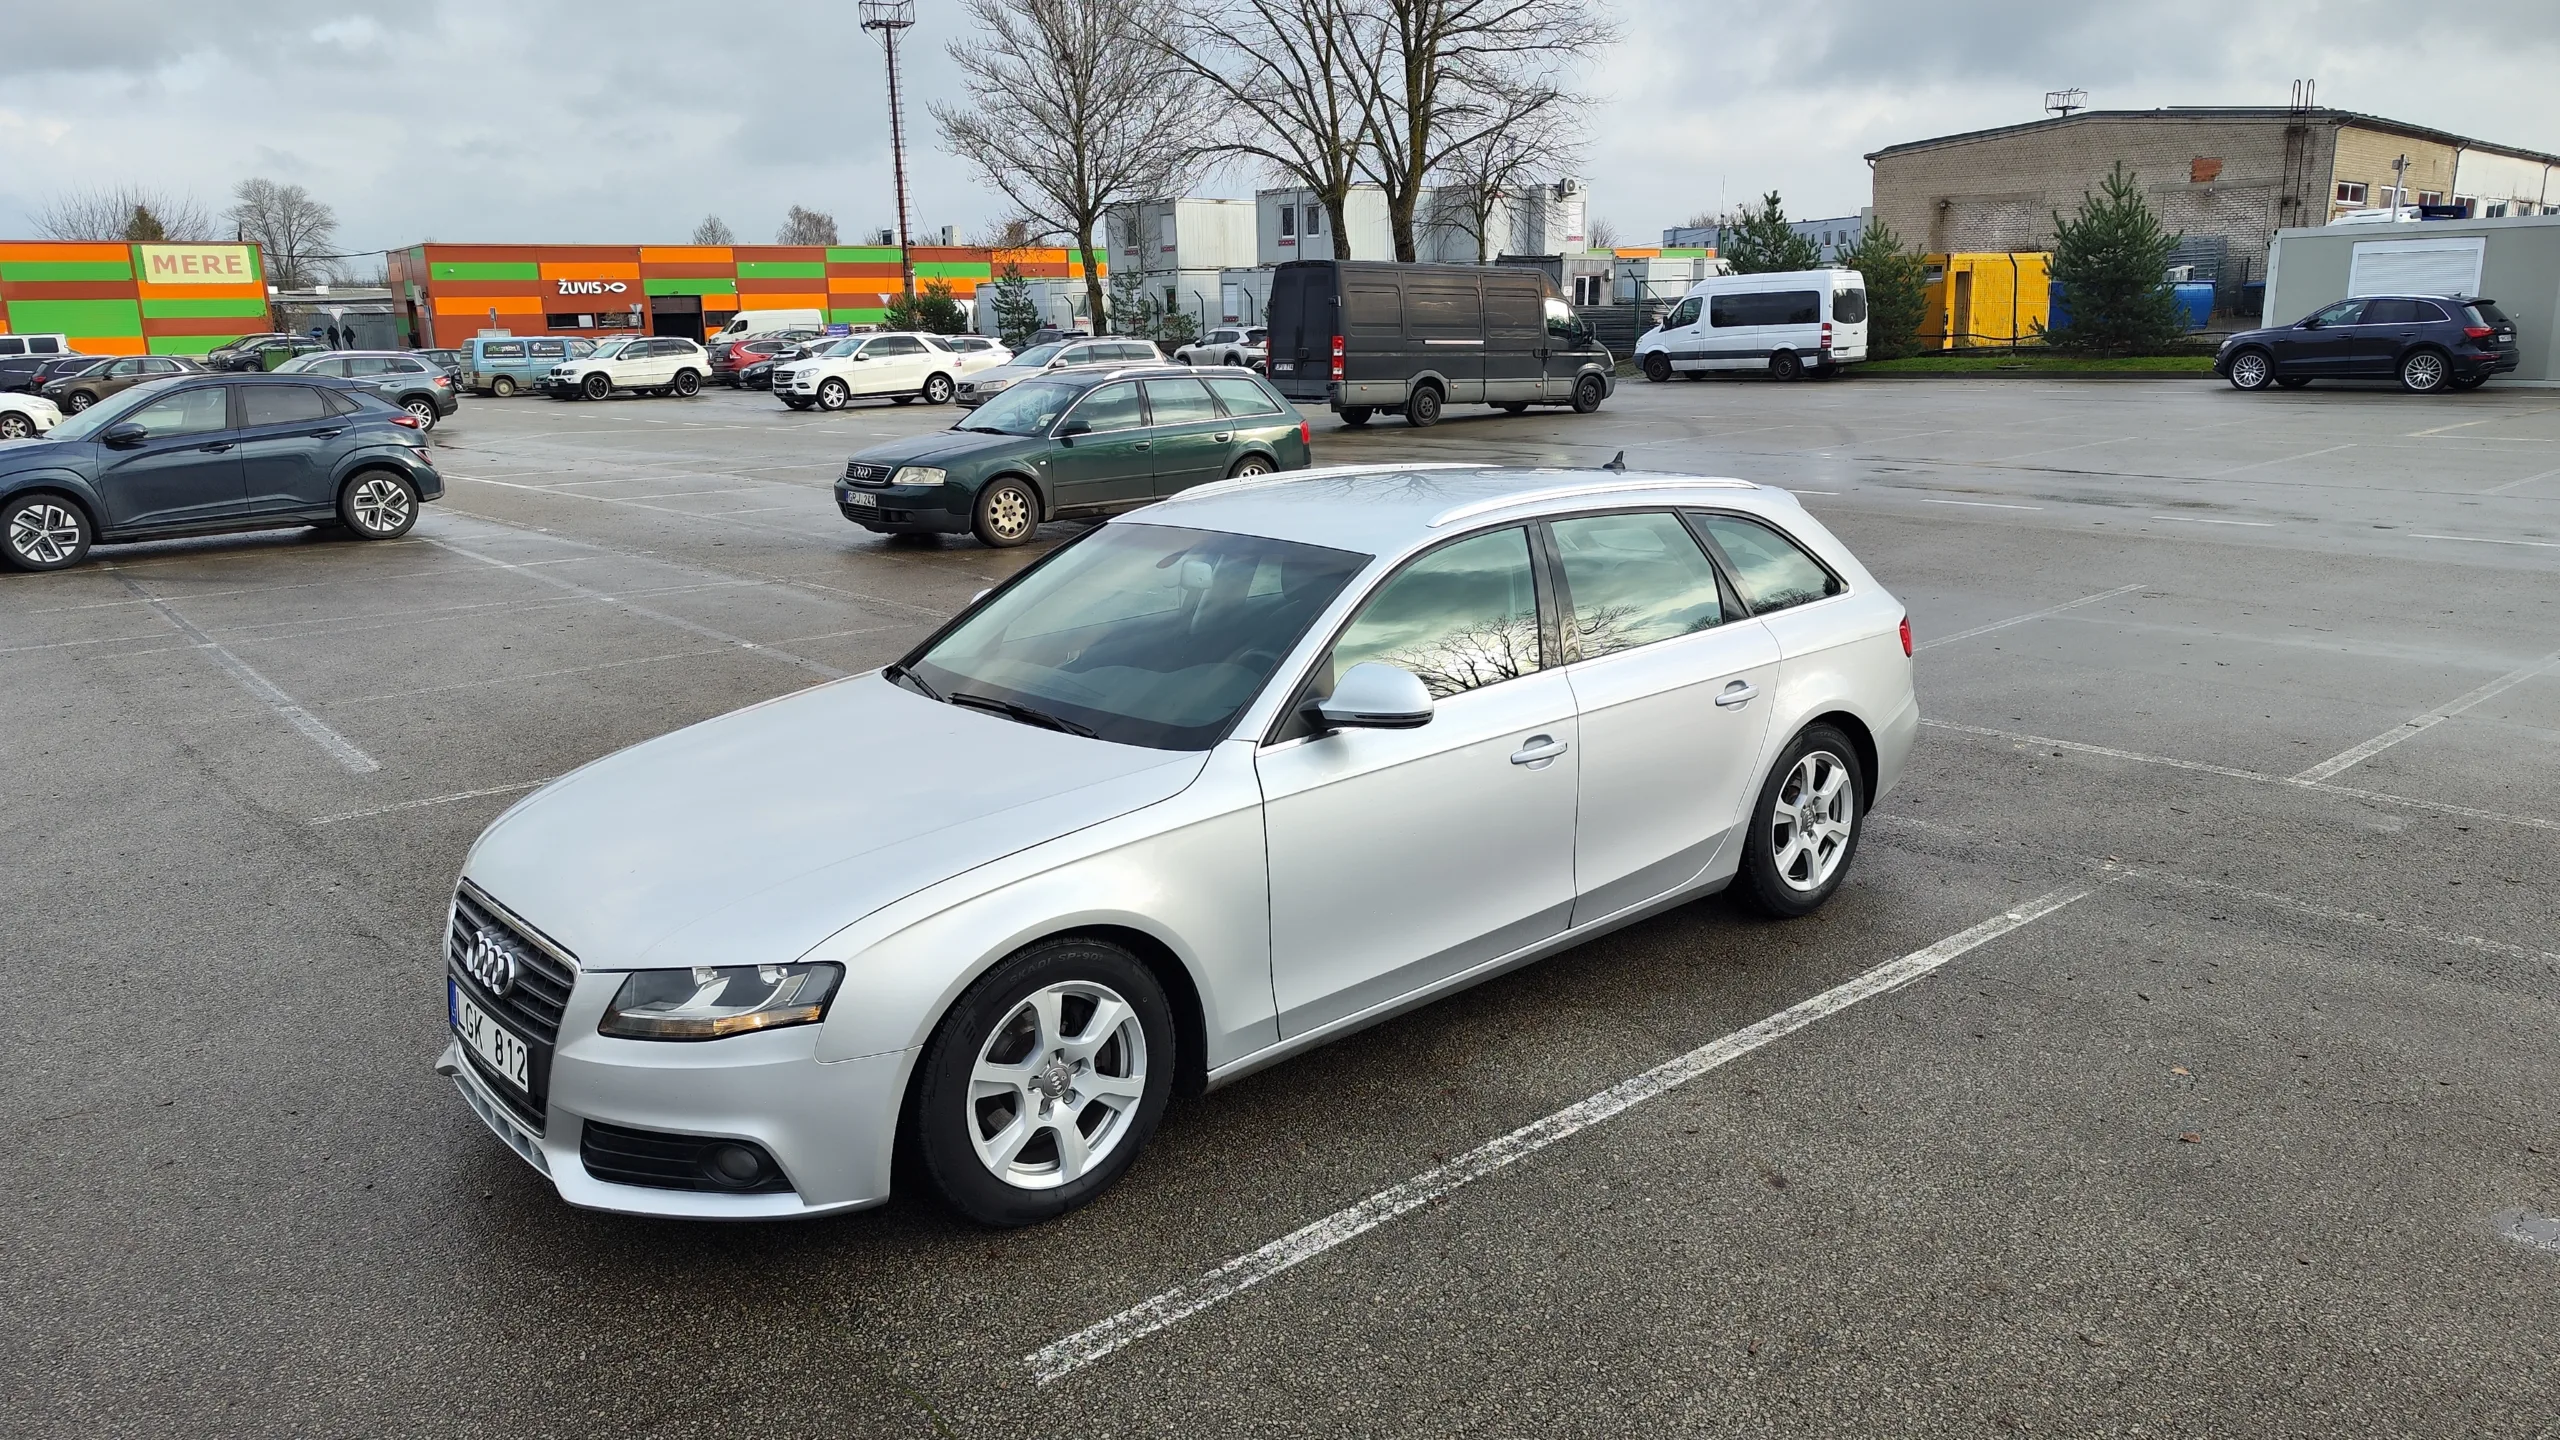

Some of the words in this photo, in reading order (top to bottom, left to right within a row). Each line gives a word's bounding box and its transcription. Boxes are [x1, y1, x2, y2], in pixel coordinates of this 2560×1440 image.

[152, 255, 243, 274] MERE
[557, 279, 602, 294] ŽUVIS
[848, 492, 861, 503] GRJ
[1009, 958, 1052, 983] SKADI
[457, 991, 484, 1051] LGK
[495, 1028, 526, 1086] 812
